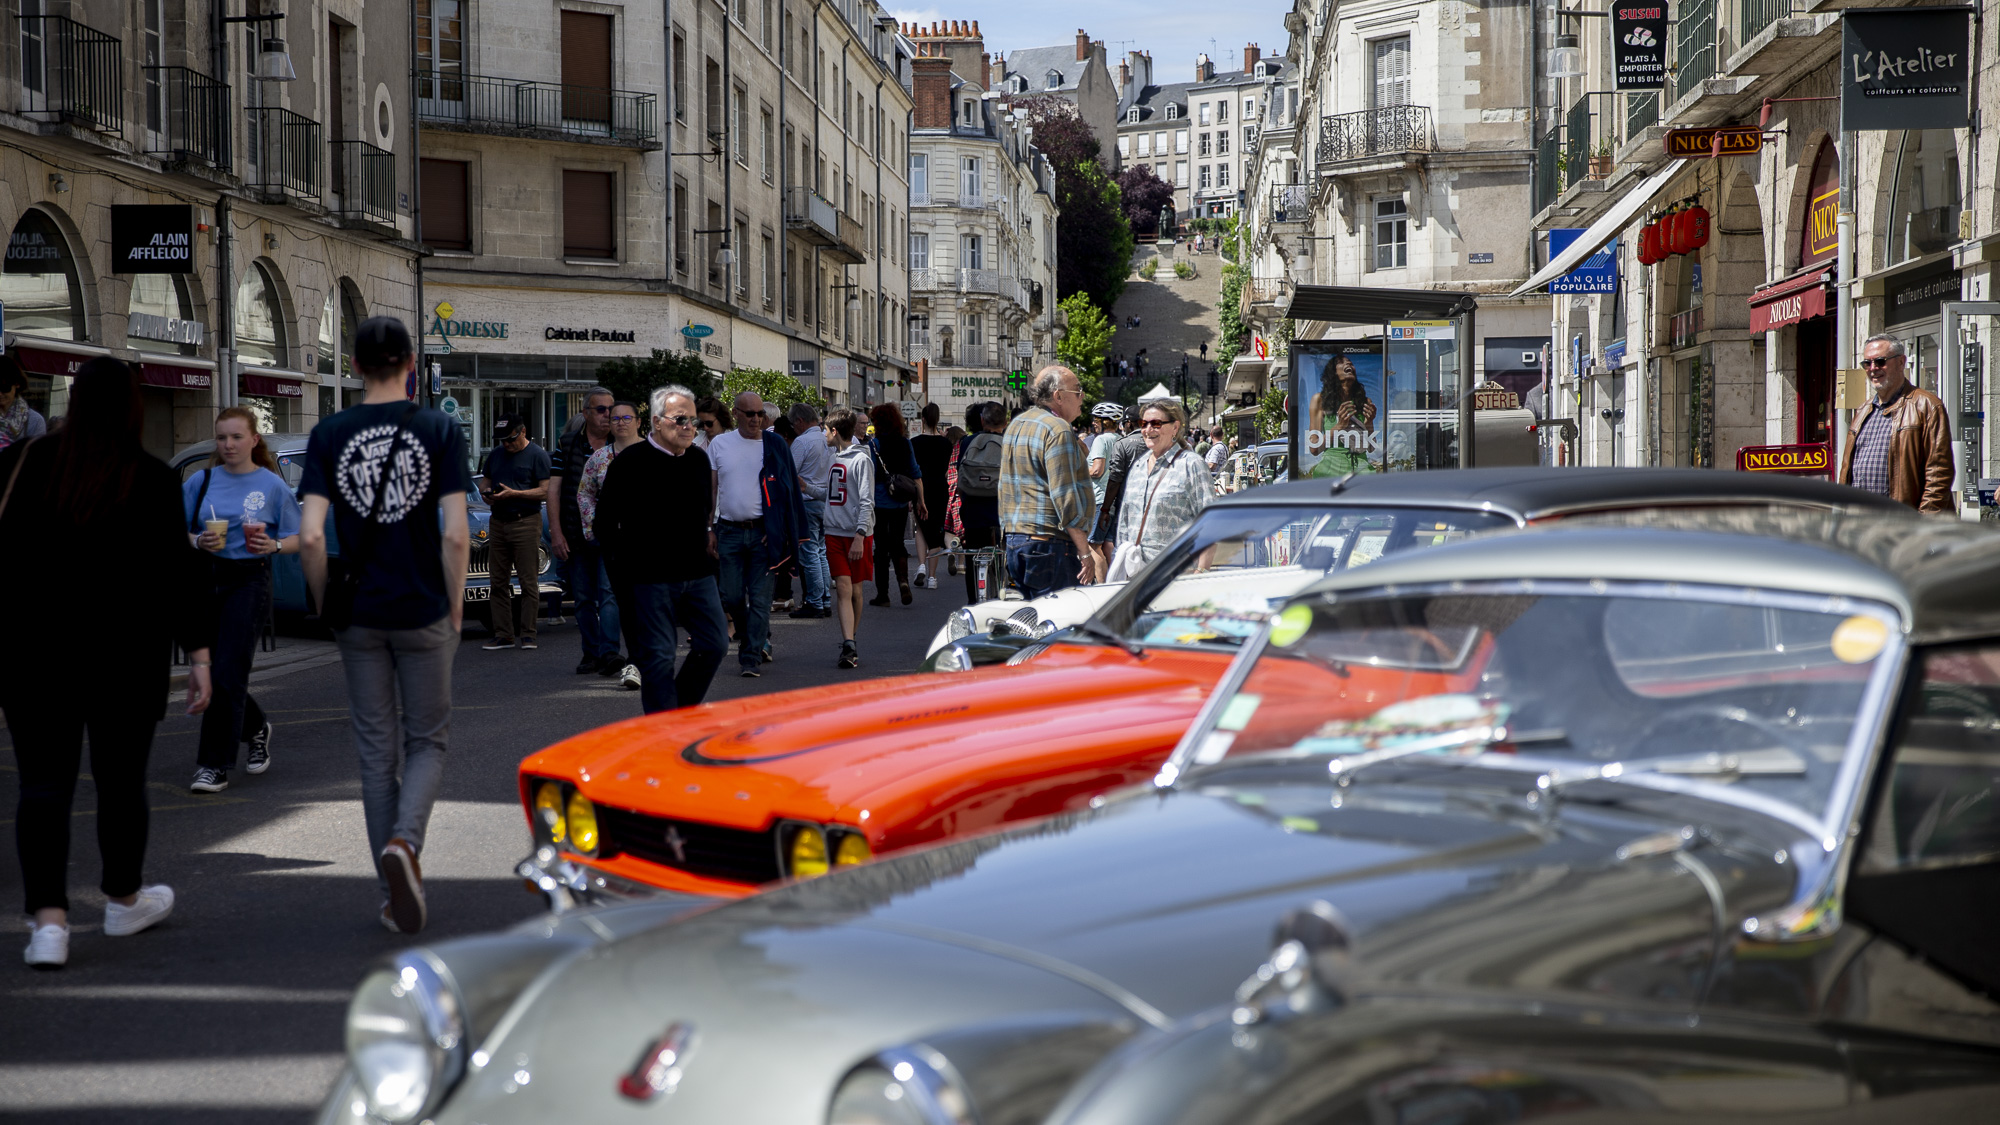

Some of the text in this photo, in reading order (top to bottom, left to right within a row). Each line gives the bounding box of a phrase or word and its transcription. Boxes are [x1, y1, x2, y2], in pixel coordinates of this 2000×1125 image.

[1619, 8, 1660, 19] SUSHI
[1625, 54, 1657, 63] PLATS À
[1853, 47, 1957, 82] L'Atelier
[1620, 64, 1662, 72] EMPORTER
[150, 233, 188, 246] ALAIN
[128, 247, 189, 260] AFFLELOU
[1897, 276, 1960, 305] coiffeurs et coloriste
[1769, 296, 1802, 324] NICOLAS
[545, 327, 635, 343] Cabinet Pautout
[952, 376, 1002, 387] PHARMACIE
[952, 389, 967, 397] DES
[1749, 452, 1823, 466] NICOLAS
